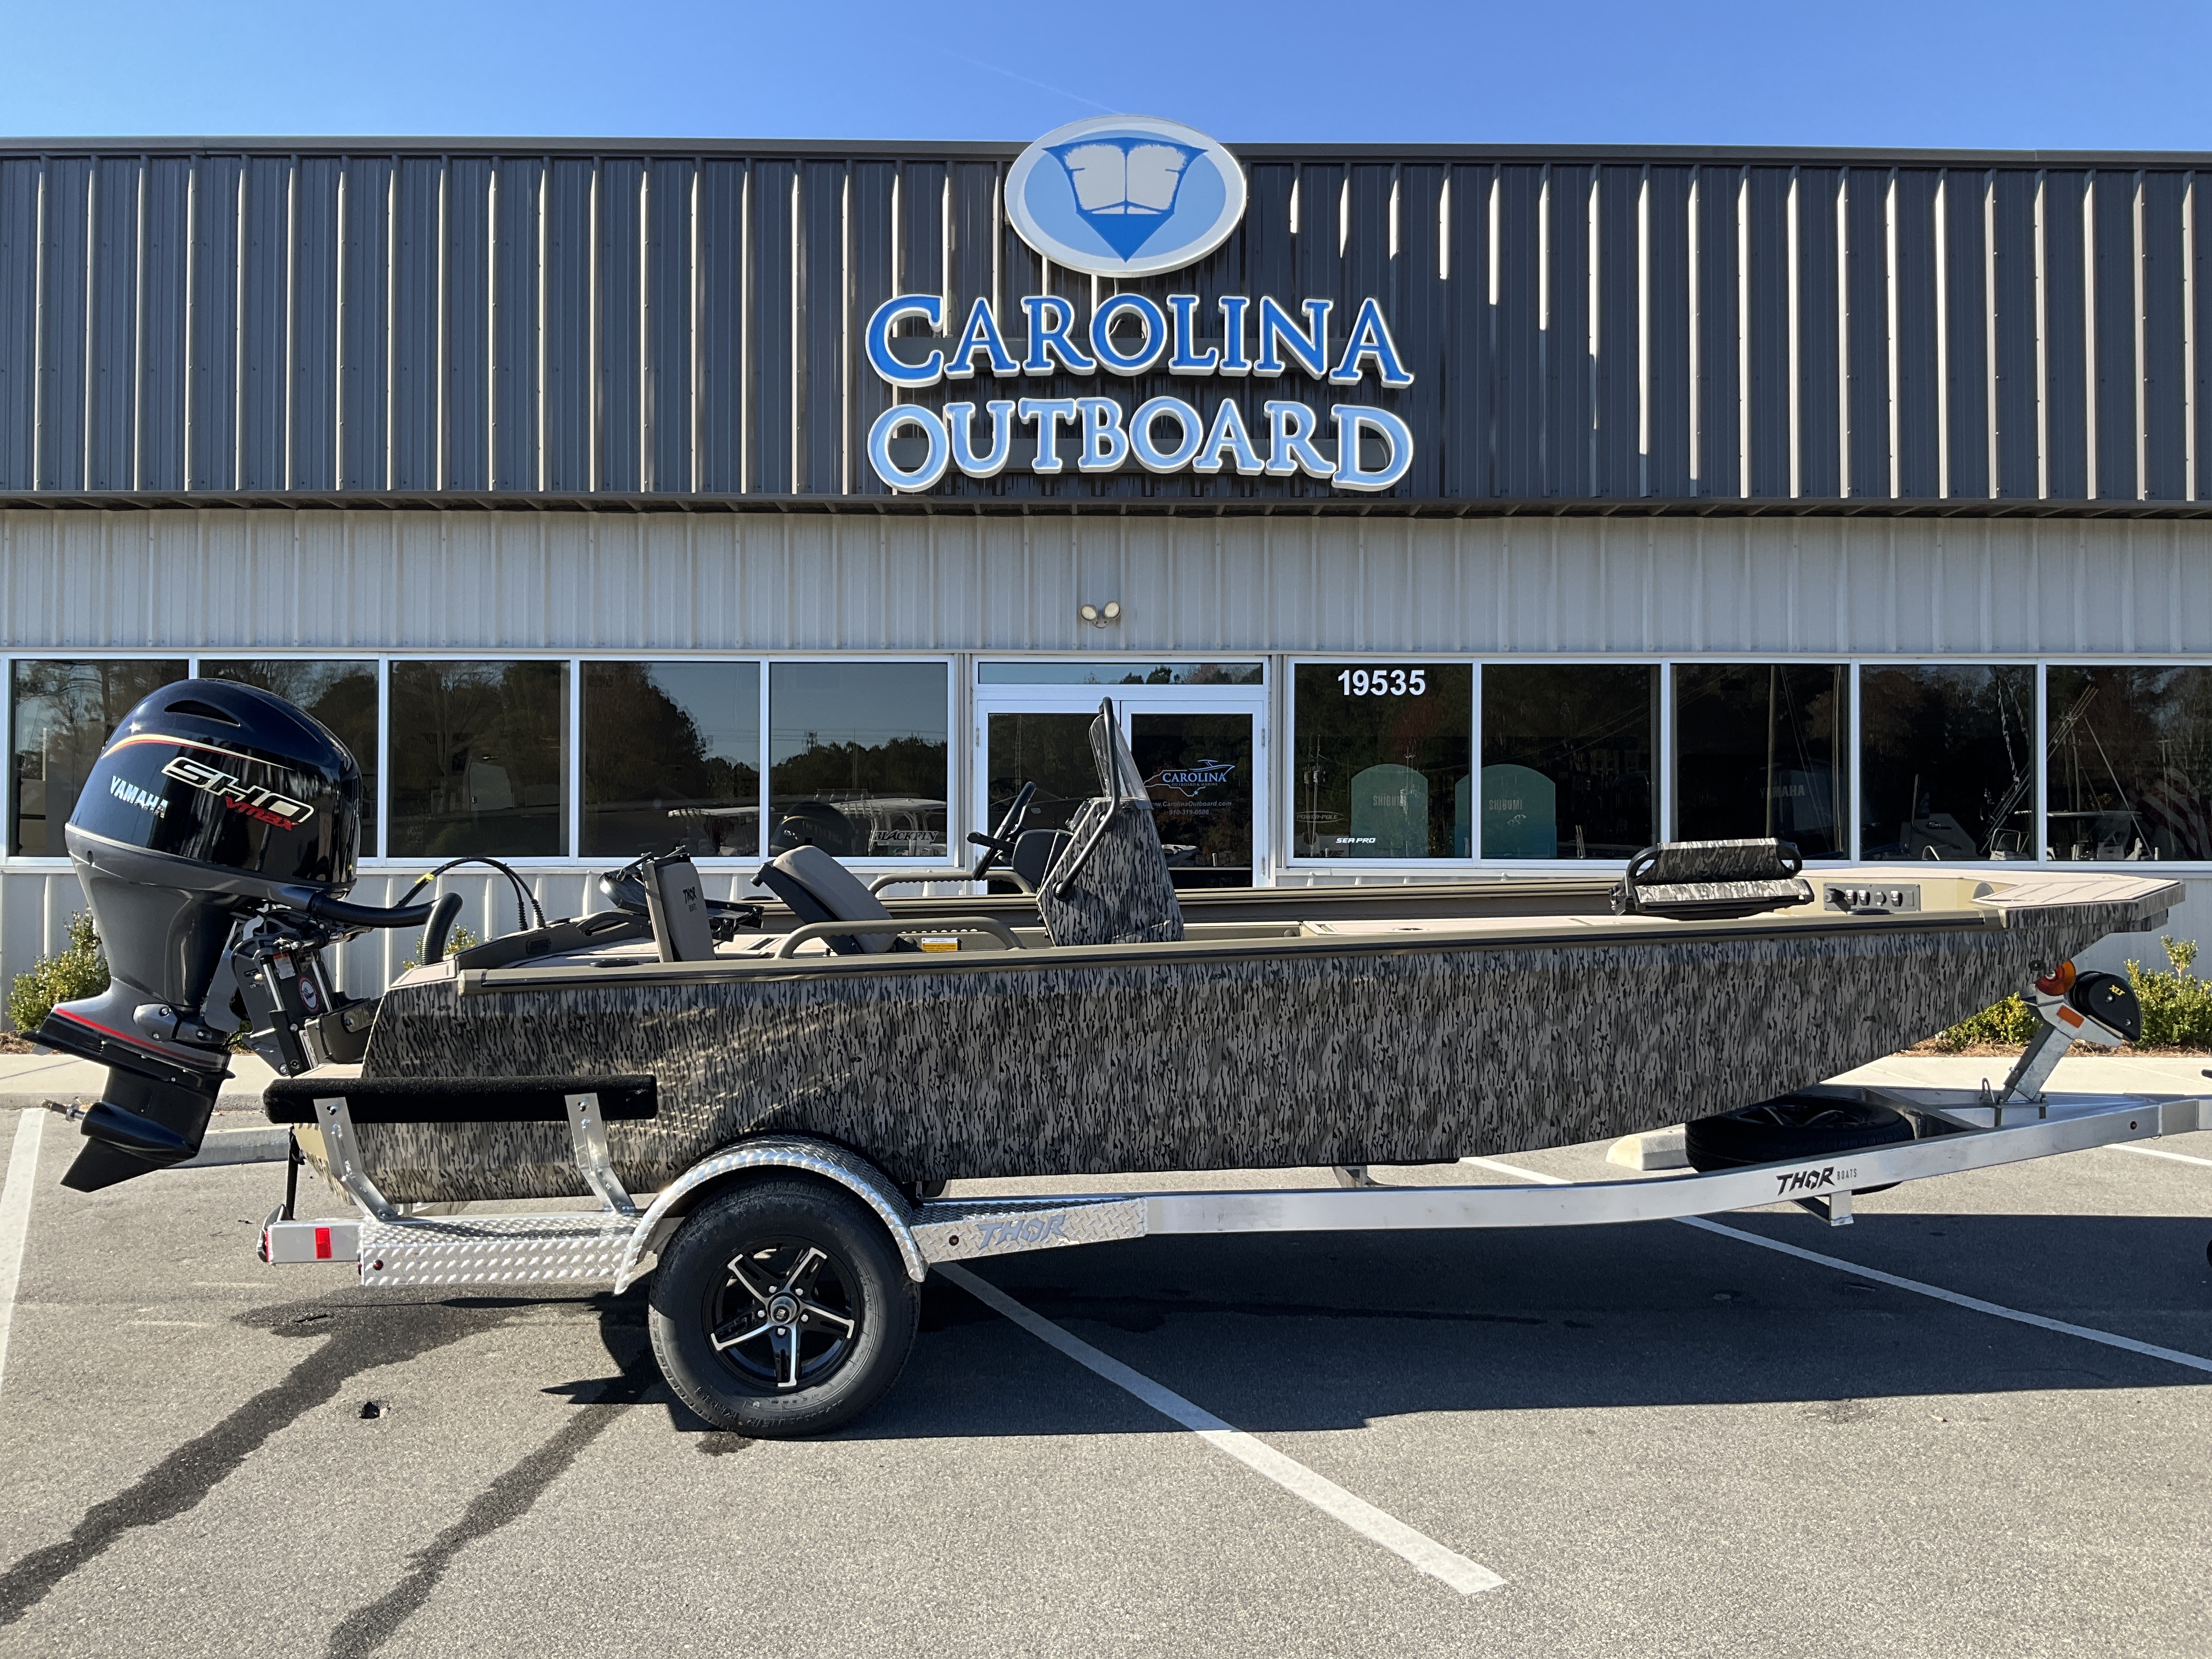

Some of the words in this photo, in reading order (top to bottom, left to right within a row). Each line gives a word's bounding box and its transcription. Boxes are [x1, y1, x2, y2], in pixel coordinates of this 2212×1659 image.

[865, 293, 1414, 388] CAROLINA
[867, 396, 1414, 492] OUTBOARD
[1338, 669, 1426, 696] 19535
[161, 757, 314, 823] SHO
[1162, 772, 1227, 782] CAROLINA
[1759, 785, 1805, 799] YMAHA
[110, 775, 169, 819] YAMAHA
[874, 830, 938, 841] BLACKFIN
[1776, 1166, 1836, 1197] THOR
[1837, 1168, 1857, 1180] BOATS
[977, 1214, 1071, 1250] THOR
